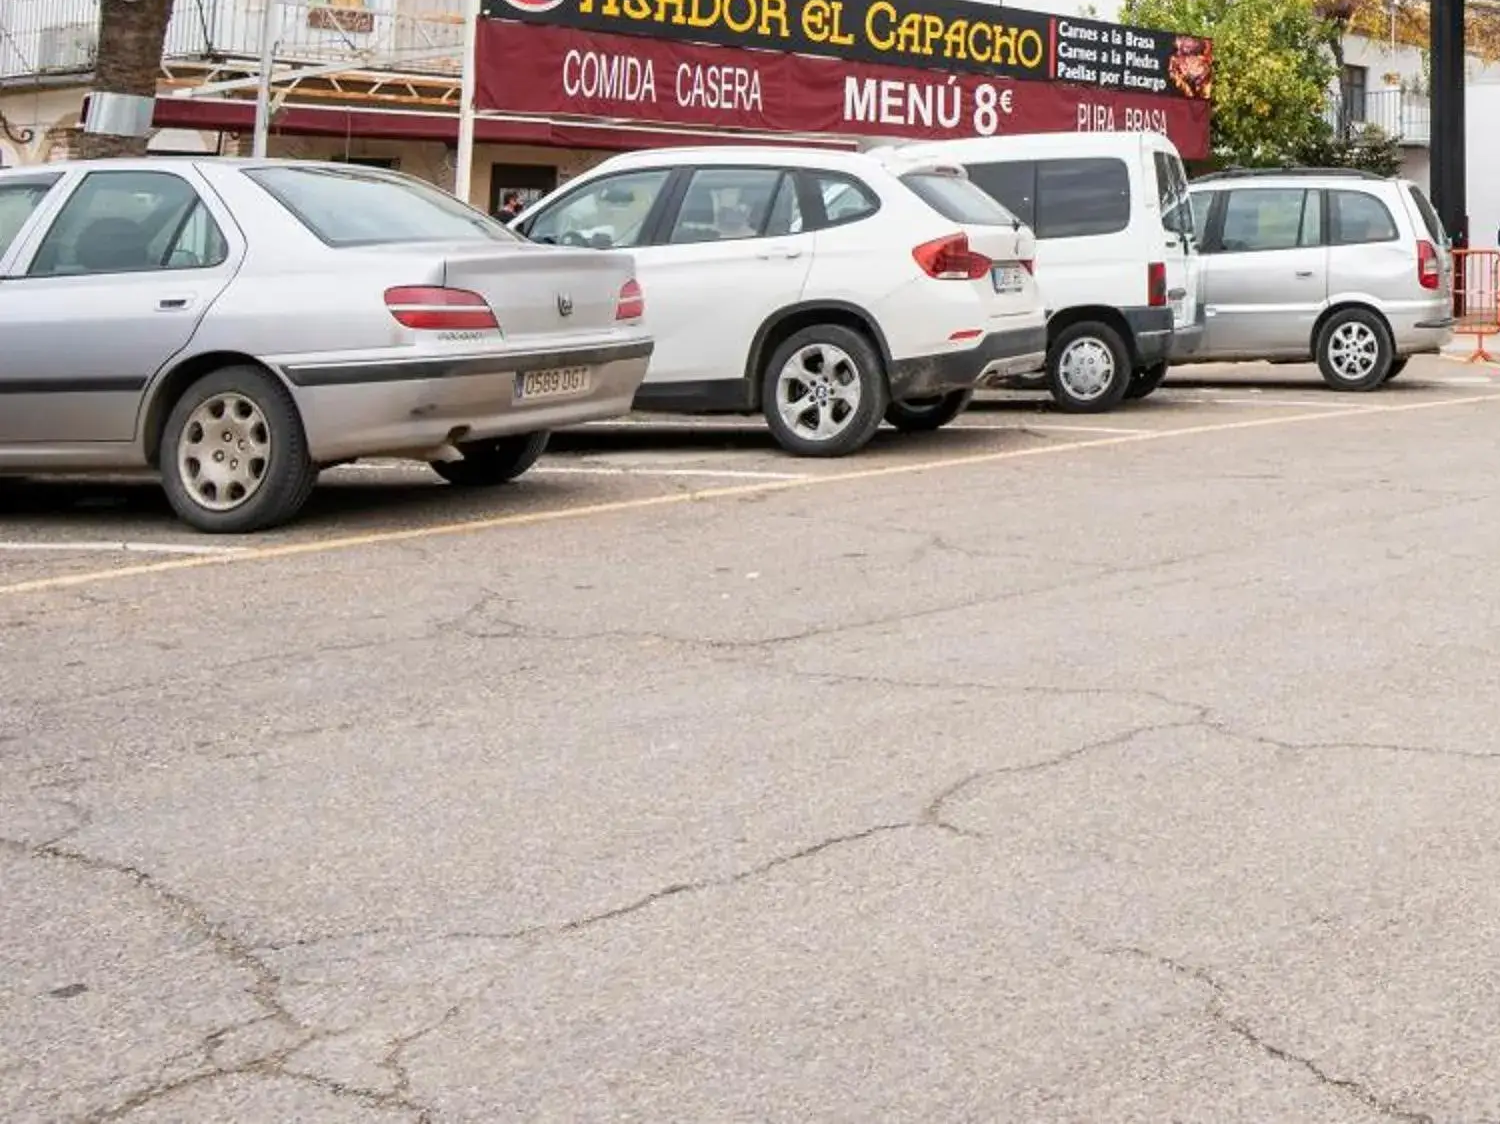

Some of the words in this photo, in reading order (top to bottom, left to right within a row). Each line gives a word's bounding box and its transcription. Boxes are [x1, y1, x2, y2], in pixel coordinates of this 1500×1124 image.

[866, 1, 1042, 68] CAPACHO
[1059, 21, 1098, 40] Carnes
[1101, 31, 1109, 44] a
[1111, 29, 1123, 45] la
[1125, 32, 1155, 49] Brasa
[1058, 42, 1097, 61] Carnes
[1101, 51, 1109, 64] a
[1111, 49, 1122, 66] la
[1126, 52, 1159, 69] Piedra
[562, 49, 657, 104] COMIDA
[676, 62, 763, 111] CASERA
[843, 75, 961, 130] MENÚ
[1058, 63, 1097, 80] Paellas
[1099, 70, 1121, 87] por
[1124, 71, 1167, 92] Encargo
